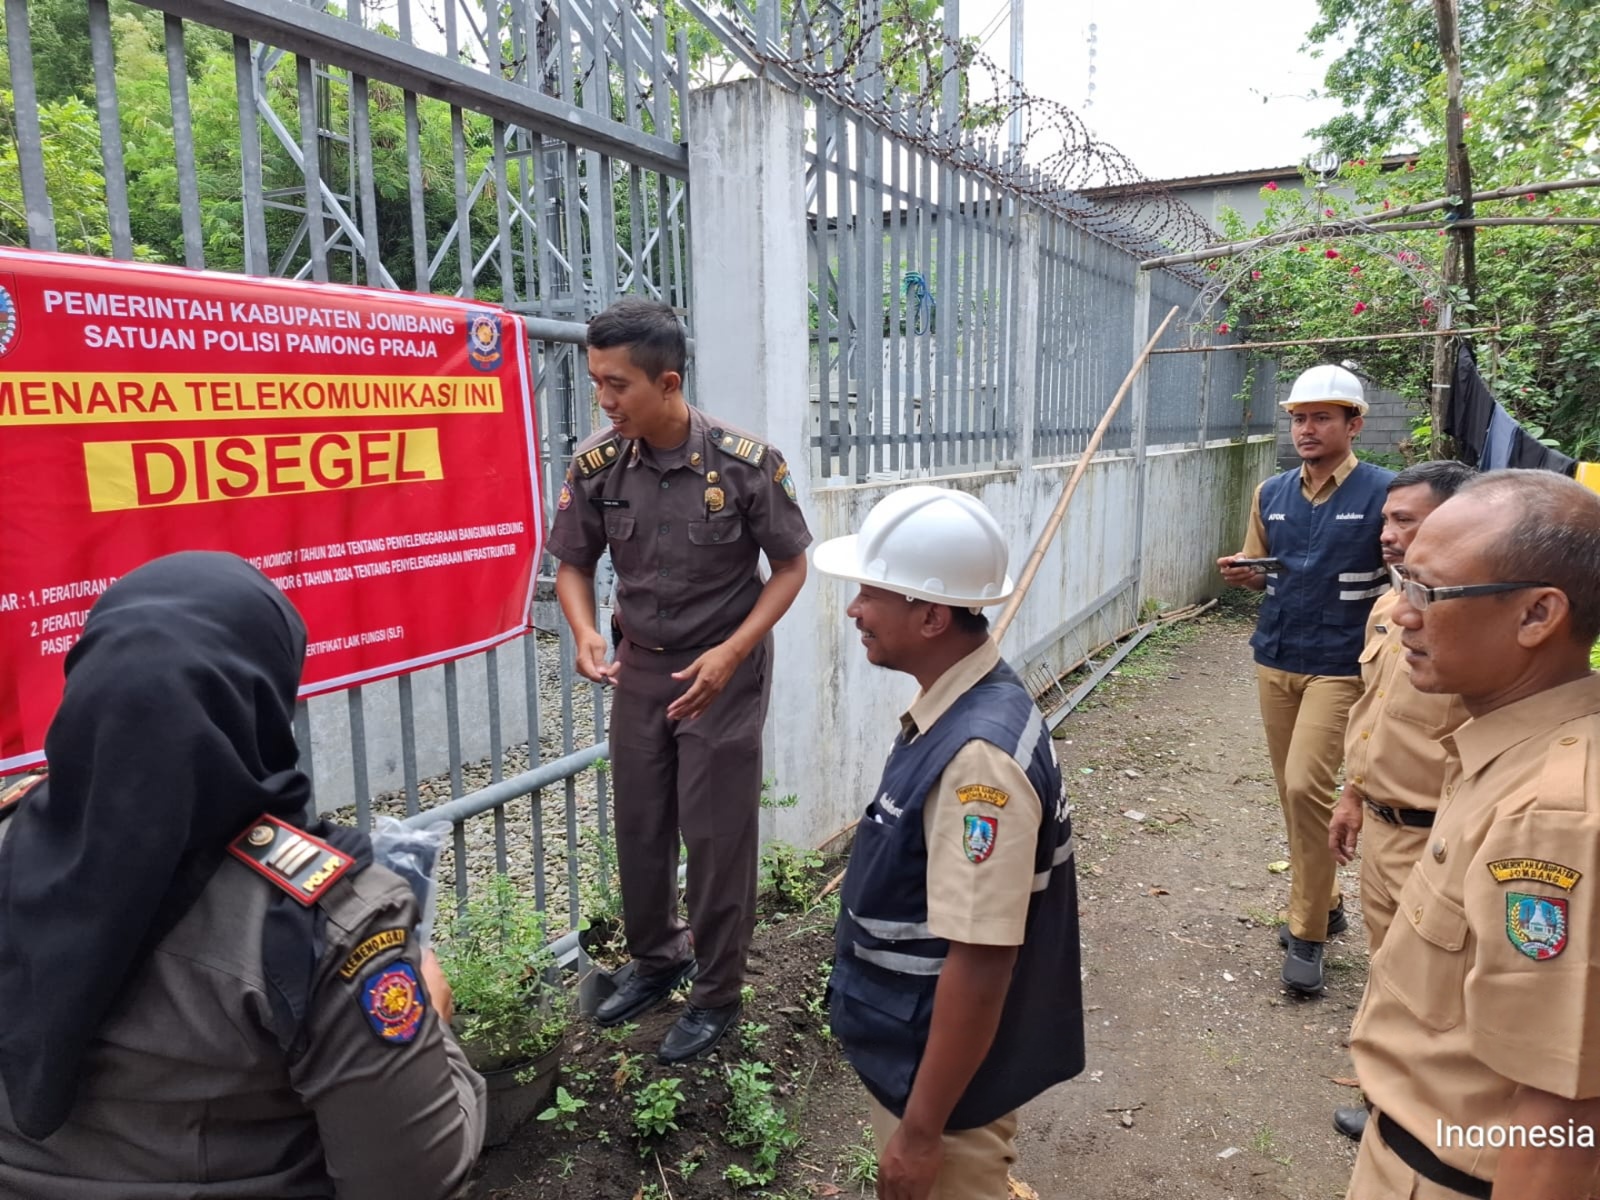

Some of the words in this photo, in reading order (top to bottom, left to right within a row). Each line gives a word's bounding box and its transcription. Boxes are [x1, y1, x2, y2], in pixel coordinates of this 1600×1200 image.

[44, 290, 223, 322] PEMERINTAH
[230, 302, 361, 329] KABUPATEN
[367, 312, 455, 335] JOMBANG
[84, 325, 196, 350] SATUAN
[203, 330, 280, 352] POLISI
[286, 333, 375, 356] PAMONG
[380, 339, 438, 358] PRAJA
[185, 381, 457, 412] TELEKOMUNIKASI
[465, 383, 495, 407] INI
[131, 432, 426, 506] DISEGEL
[263, 551, 292, 568] NOMOR
[294, 550, 298, 563] 1
[300, 545, 327, 562] TAHUN
[327, 543, 346, 558] 2024
[346, 538, 385, 556] TENTANG
[459, 524, 497, 541] BANGUNAN
[496, 522, 524, 536] GEDUNG
[296, 574, 303, 588] 6
[303, 570, 333, 587] TAHUN
[333, 567, 354, 582] 2024
[353, 562, 391, 579] TENTANG
[463, 543, 516, 562] INFRASTRUKTUR
[0, 593, 20, 612] AR
[29, 590, 40, 607] 1.
[41, 578, 107, 606] PERATURAN
[306, 637, 343, 657] ERTIFIKAT
[343, 634, 361, 649] LAIK
[361, 629, 386, 645] FUNGSI
[386, 625, 405, 642] (SLF)
[1509, 869, 1560, 883] JOMBANG
